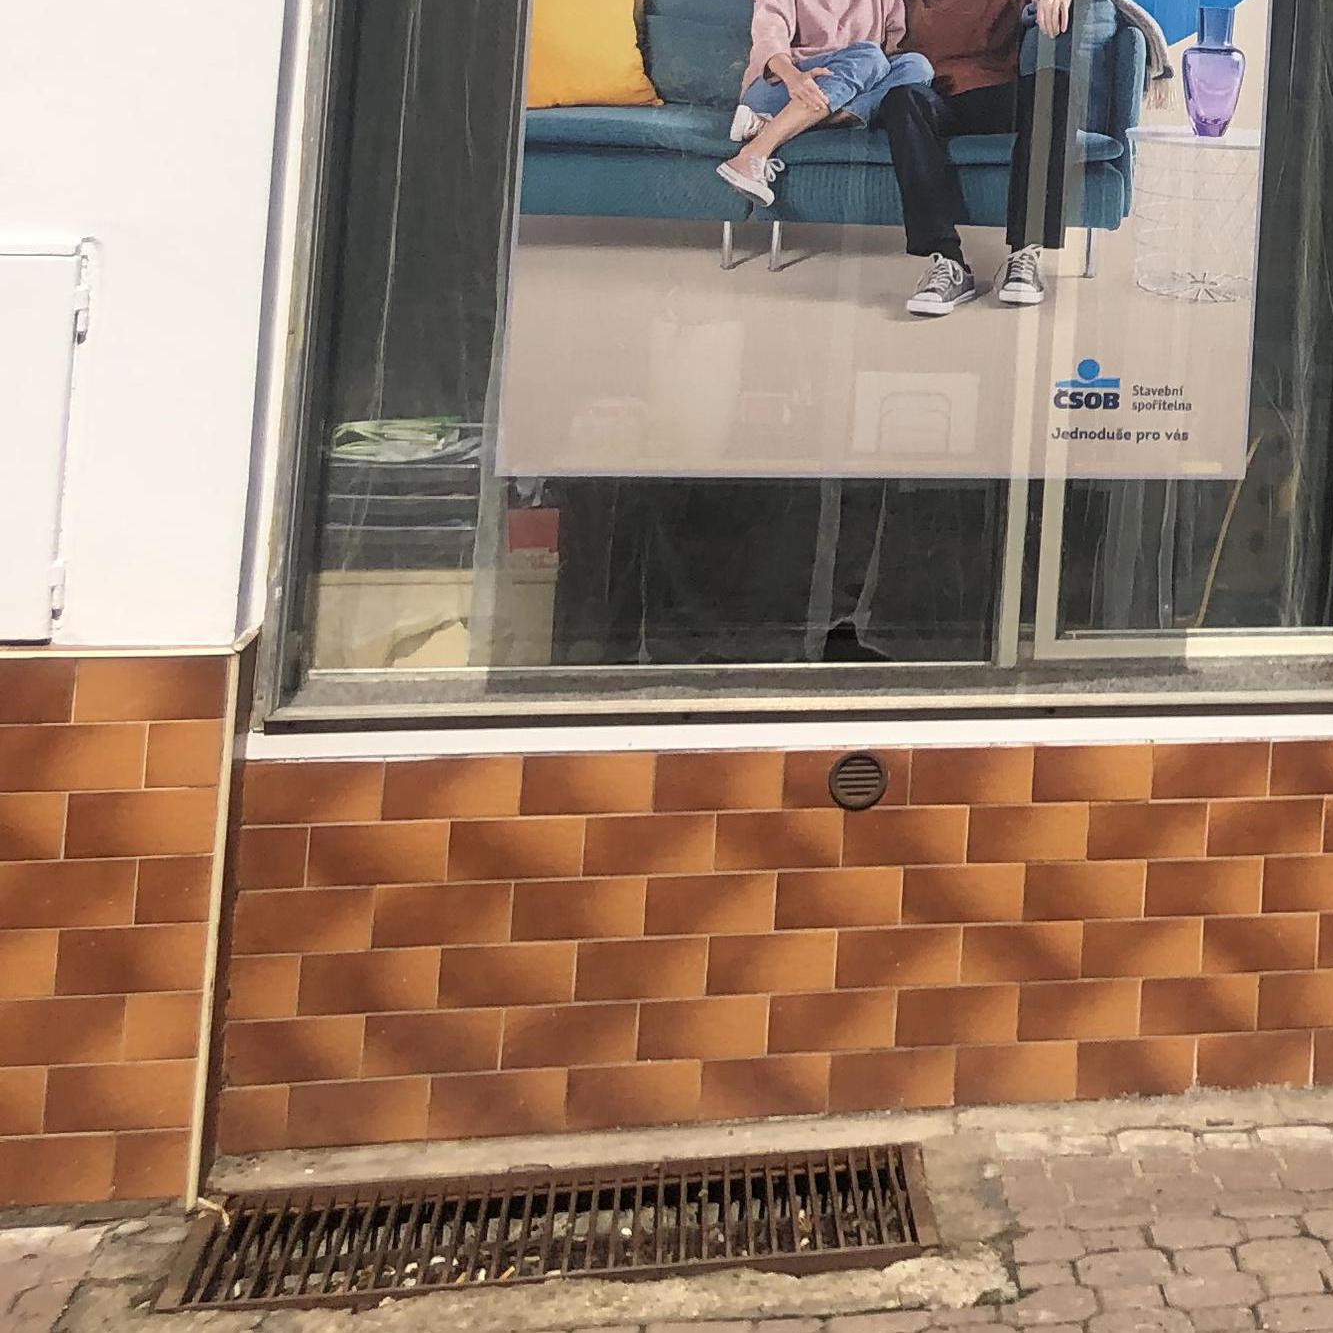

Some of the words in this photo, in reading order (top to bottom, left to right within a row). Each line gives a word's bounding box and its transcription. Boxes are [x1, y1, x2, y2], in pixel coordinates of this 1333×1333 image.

[1132, 385, 1183, 397] Stavební
[1053, 389, 1120, 410] ČSOB
[1132, 399, 1192, 412] spořitelna
[1051, 427, 1131, 441] Jednoduše
[1136, 431, 1161, 443] pro
[1165, 428, 1189, 441] vás
